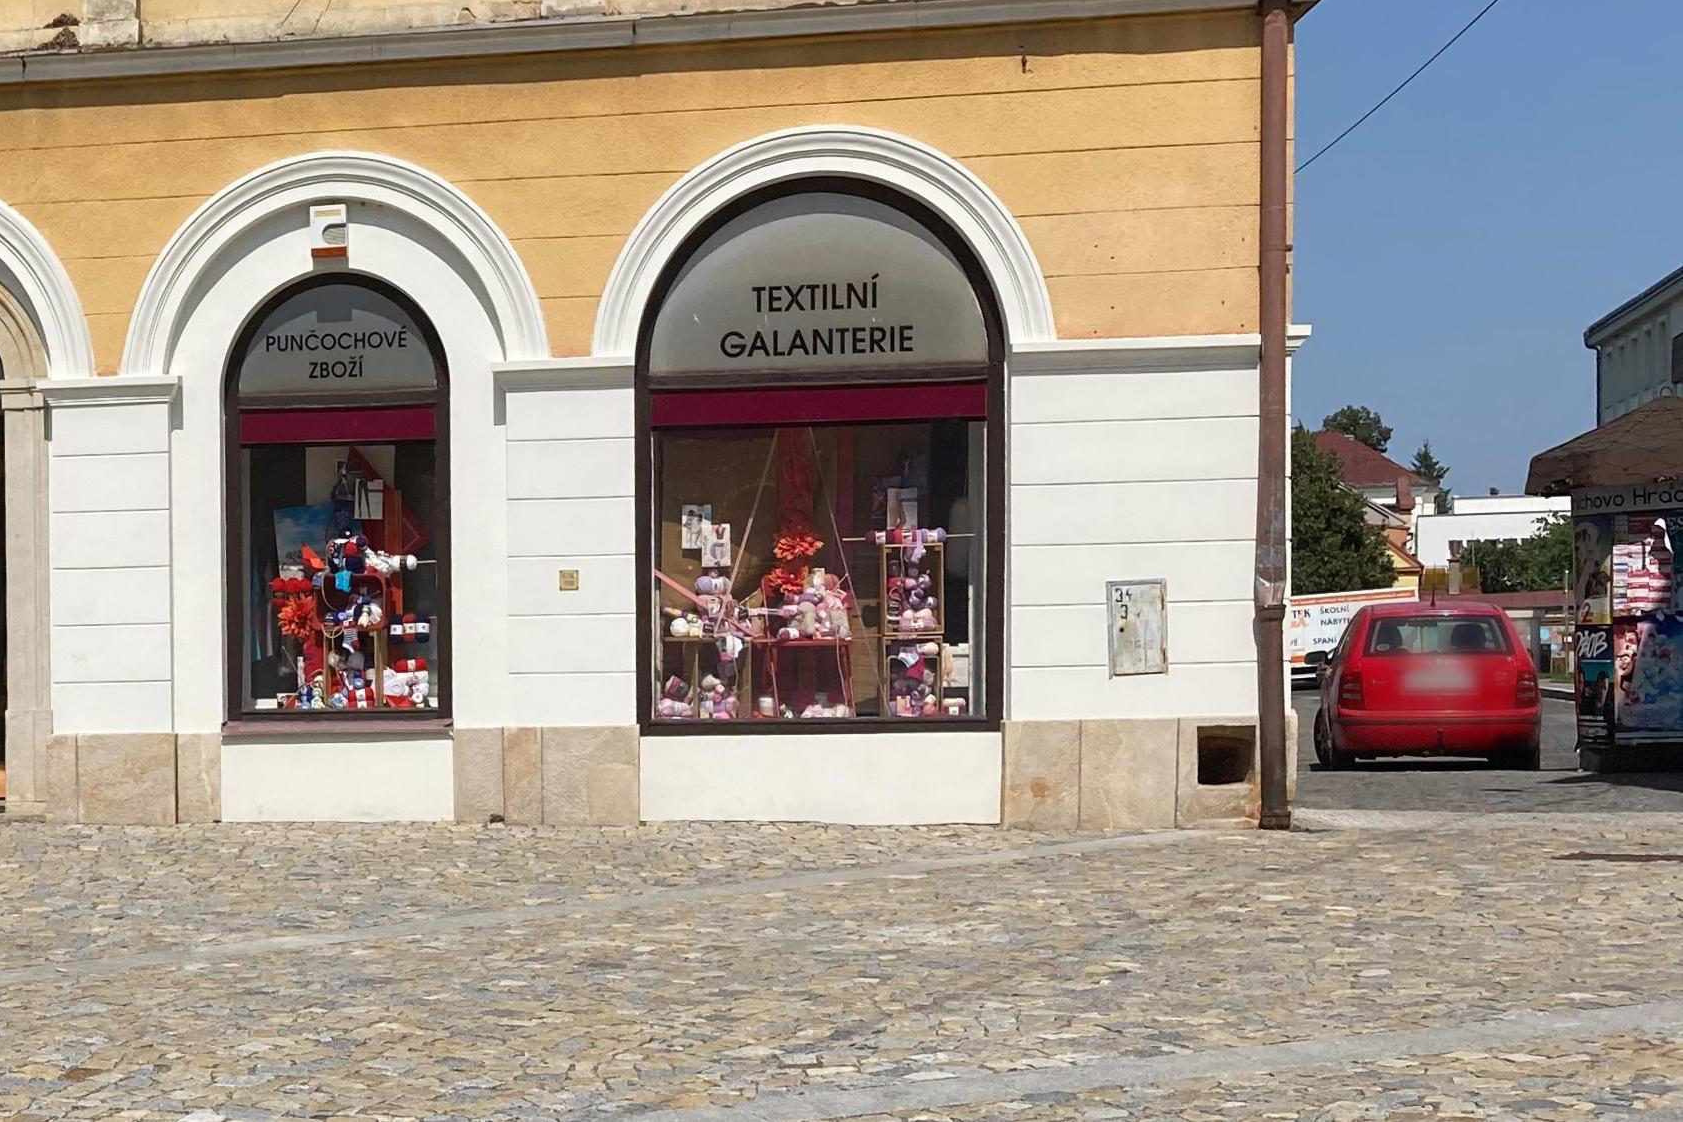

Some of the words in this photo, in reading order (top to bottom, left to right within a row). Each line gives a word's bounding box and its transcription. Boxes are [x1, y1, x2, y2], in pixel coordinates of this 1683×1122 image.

[752, 273, 879, 313] TEXTILNÍ
[266, 325, 407, 352] PUNČOCHOVÉ
[720, 325, 914, 358] GALANTERIE
[309, 355, 364, 379] ZBOŽÍ
